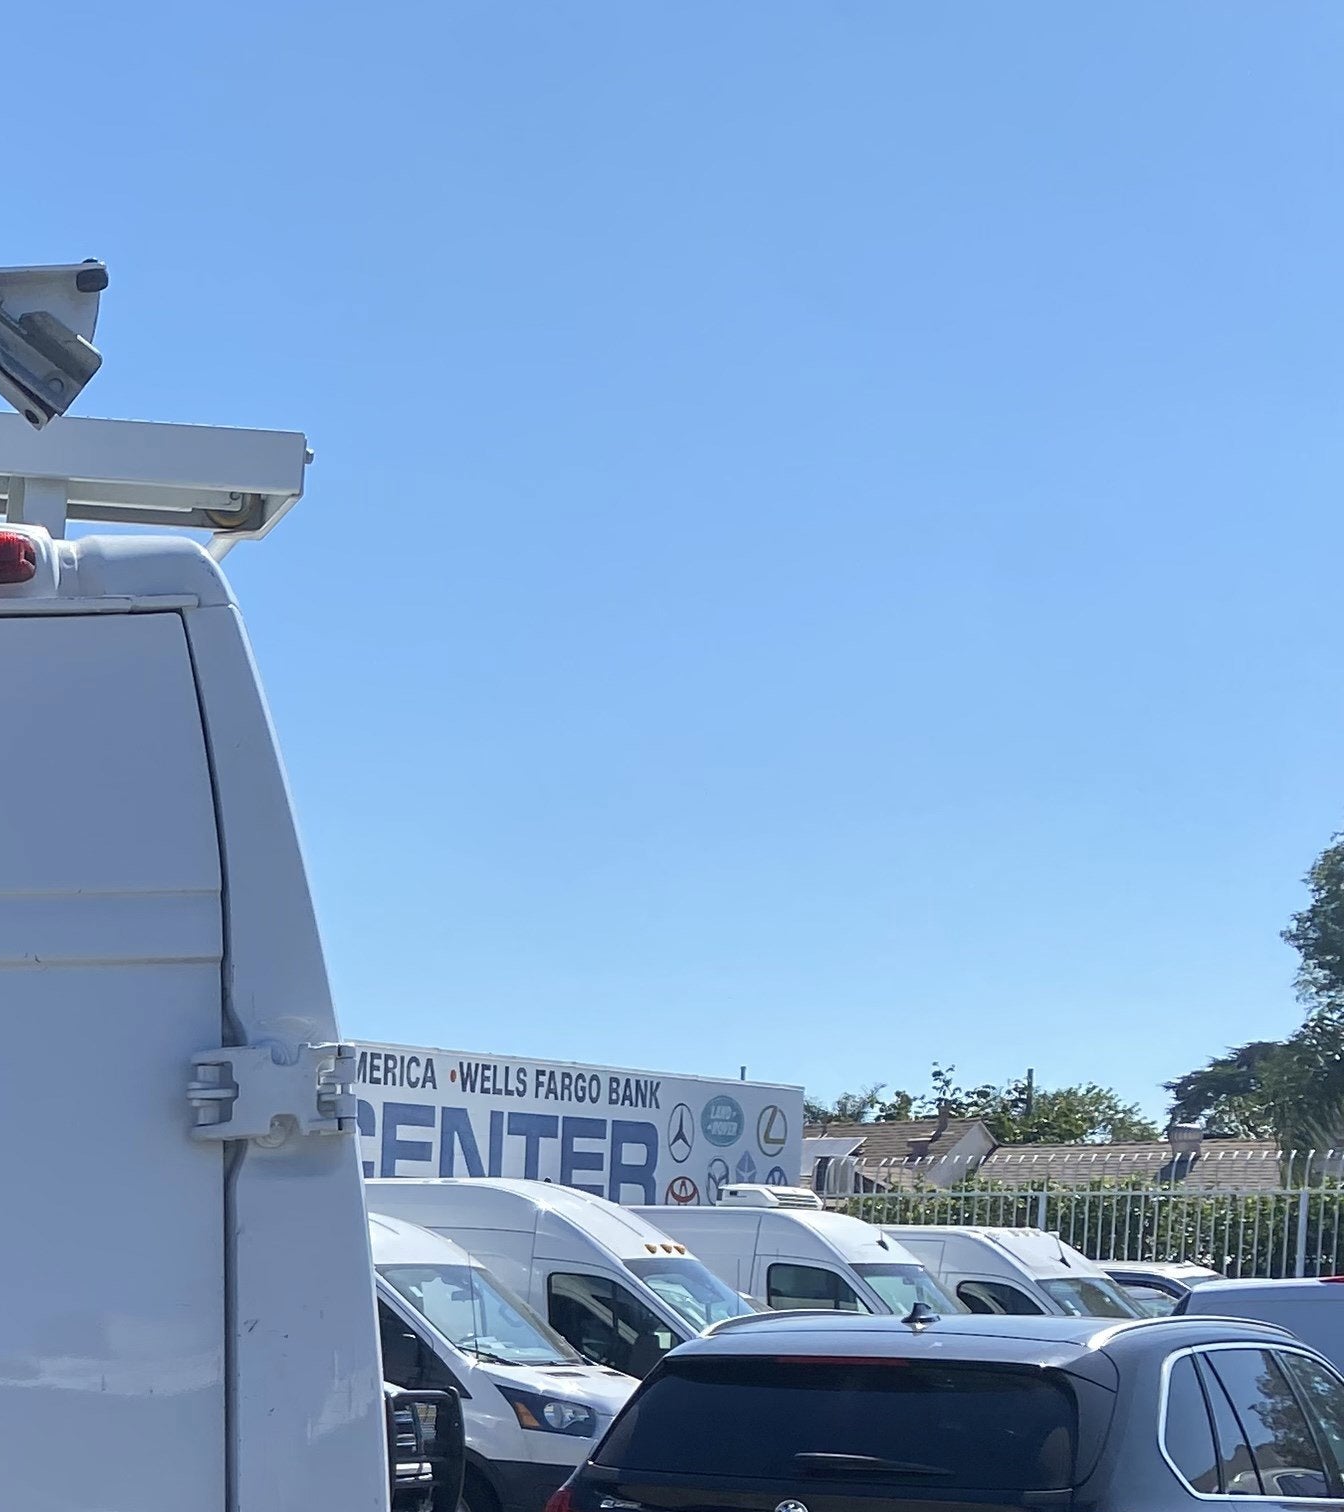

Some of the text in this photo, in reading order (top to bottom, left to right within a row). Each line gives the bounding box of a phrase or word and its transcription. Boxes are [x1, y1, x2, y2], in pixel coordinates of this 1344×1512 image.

[459, 1061, 528, 1098] WELLS
[534, 1069, 602, 1104] FARGO
[608, 1076, 661, 1109] BANK
